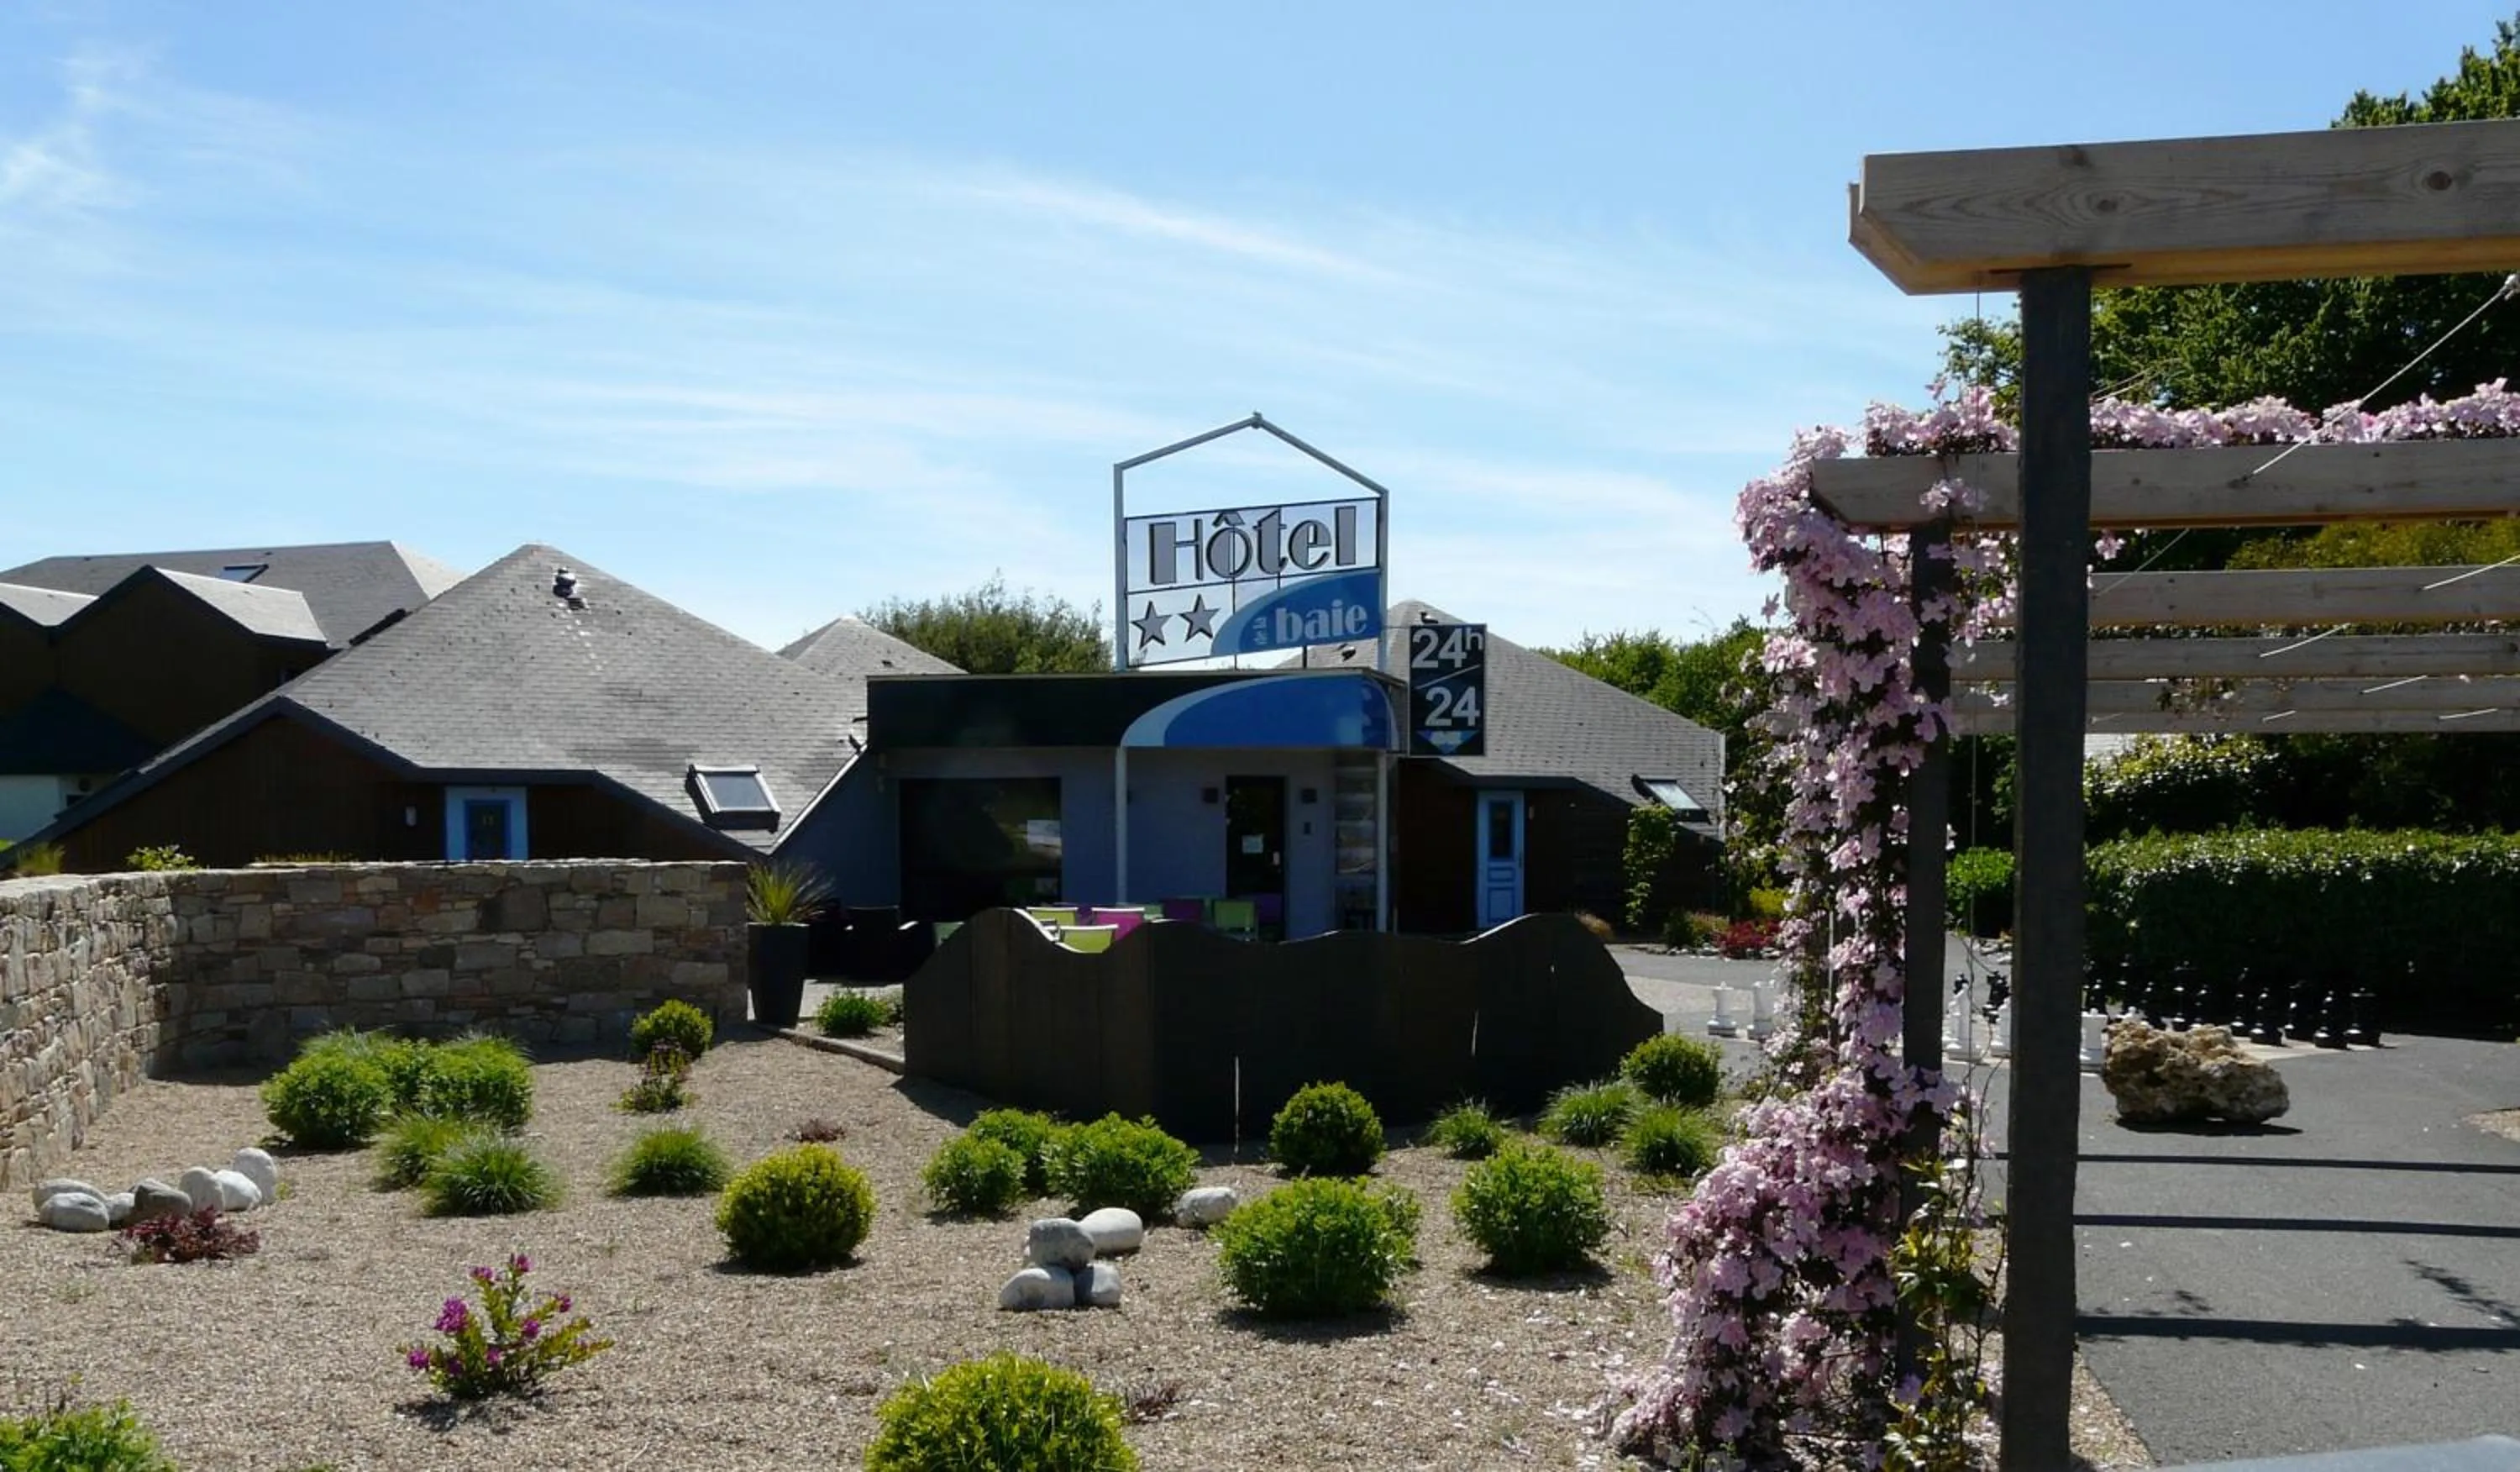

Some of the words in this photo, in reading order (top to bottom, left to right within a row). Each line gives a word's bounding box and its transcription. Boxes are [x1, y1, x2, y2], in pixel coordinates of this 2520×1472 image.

[1149, 506, 1357, 585] Hôtel
[1275, 599, 1368, 644] baie
[1411, 628, 1483, 669] 24h
[1425, 686, 1480, 727] 24
